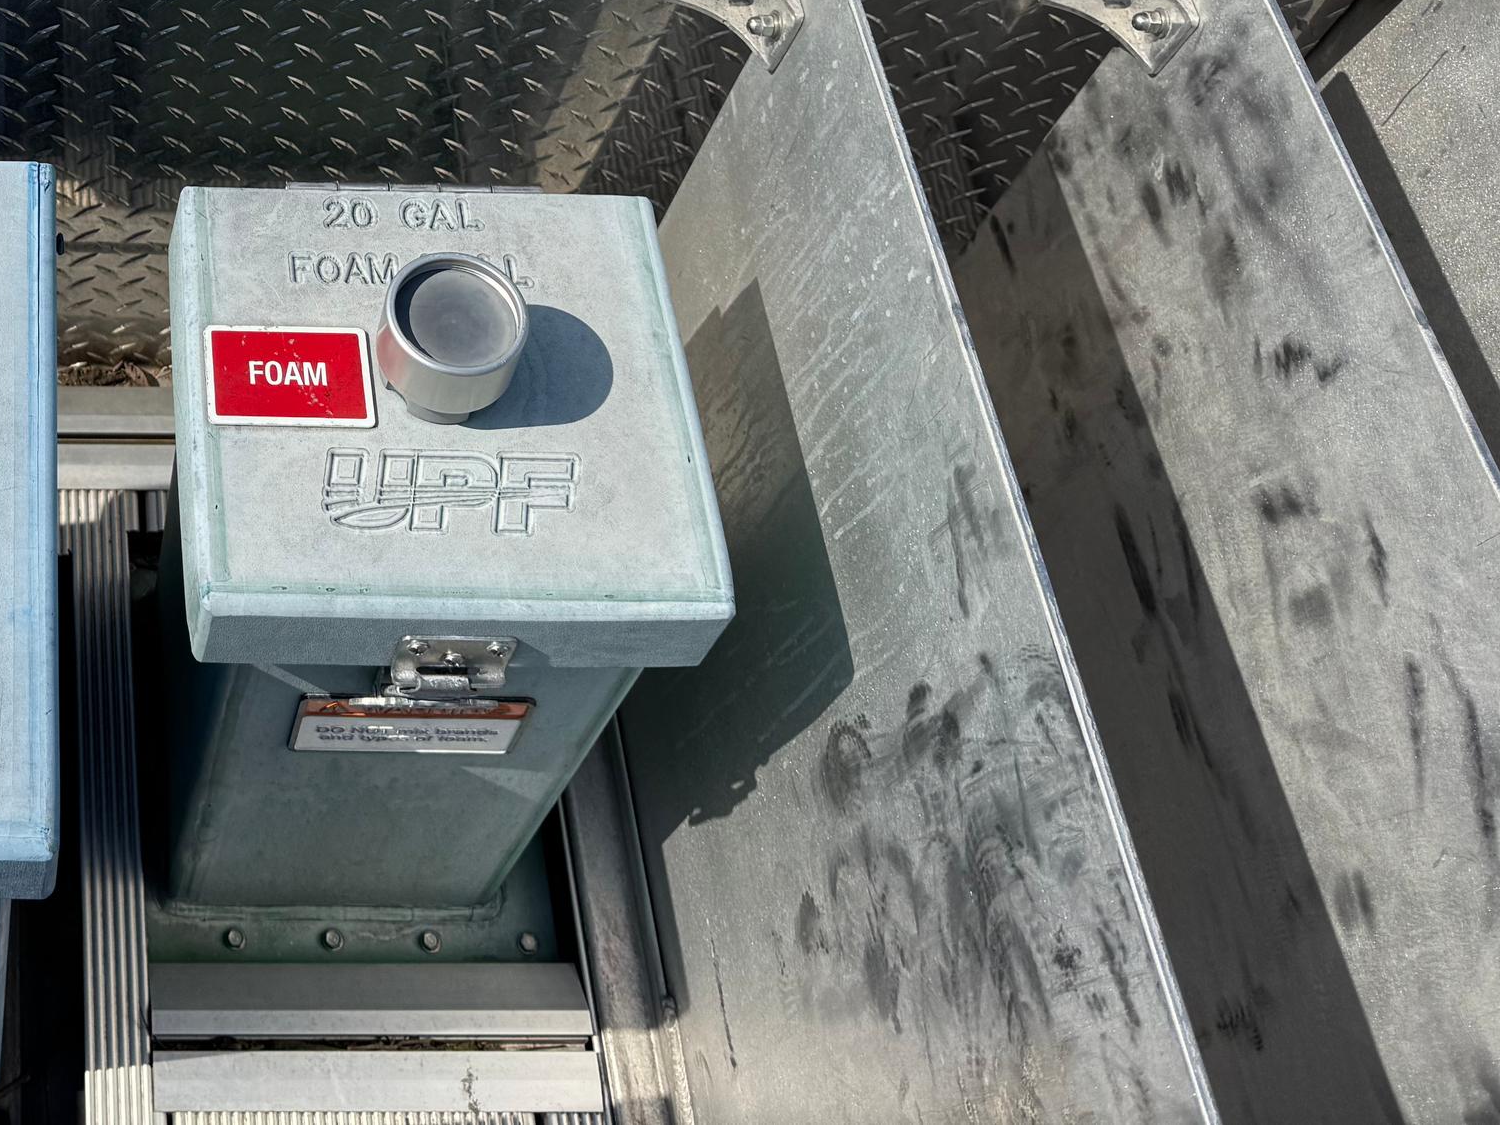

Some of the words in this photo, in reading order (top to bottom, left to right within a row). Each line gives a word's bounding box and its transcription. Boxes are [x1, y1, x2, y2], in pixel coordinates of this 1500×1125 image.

[322, 197, 378, 229] 20
[399, 199, 485, 232] GAL
[288, 251, 399, 286] FOAM
[247, 360, 328, 387] FOAM
[322, 447, 582, 536] UPF
[316, 726, 345, 734] DO
